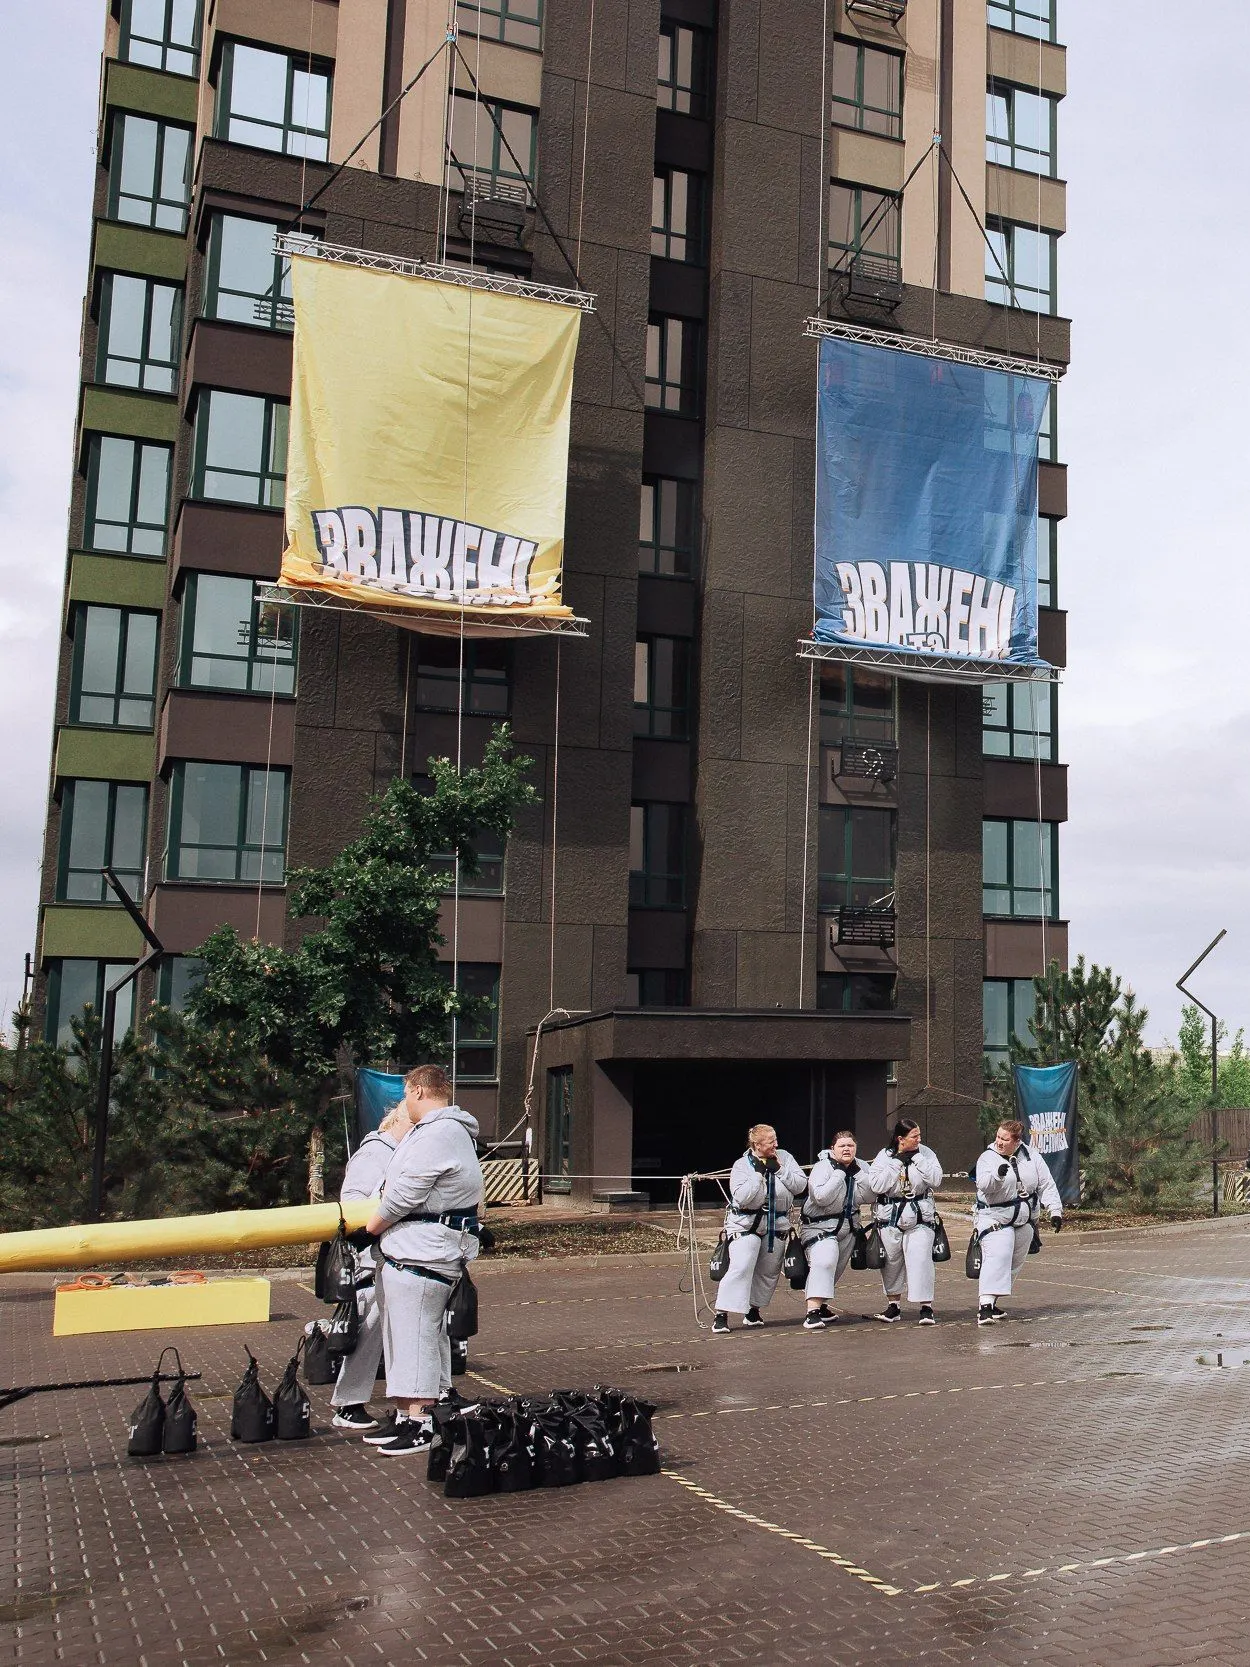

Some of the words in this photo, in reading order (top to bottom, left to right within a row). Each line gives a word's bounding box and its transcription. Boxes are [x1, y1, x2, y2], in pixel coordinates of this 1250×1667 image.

[312, 507, 538, 594] ЗВАЖЕНІ
[835, 561, 1017, 652] ЗВАЖЕНІ
[973, 1258, 980, 1270] 5
[302, 1401, 310, 1419] 5
